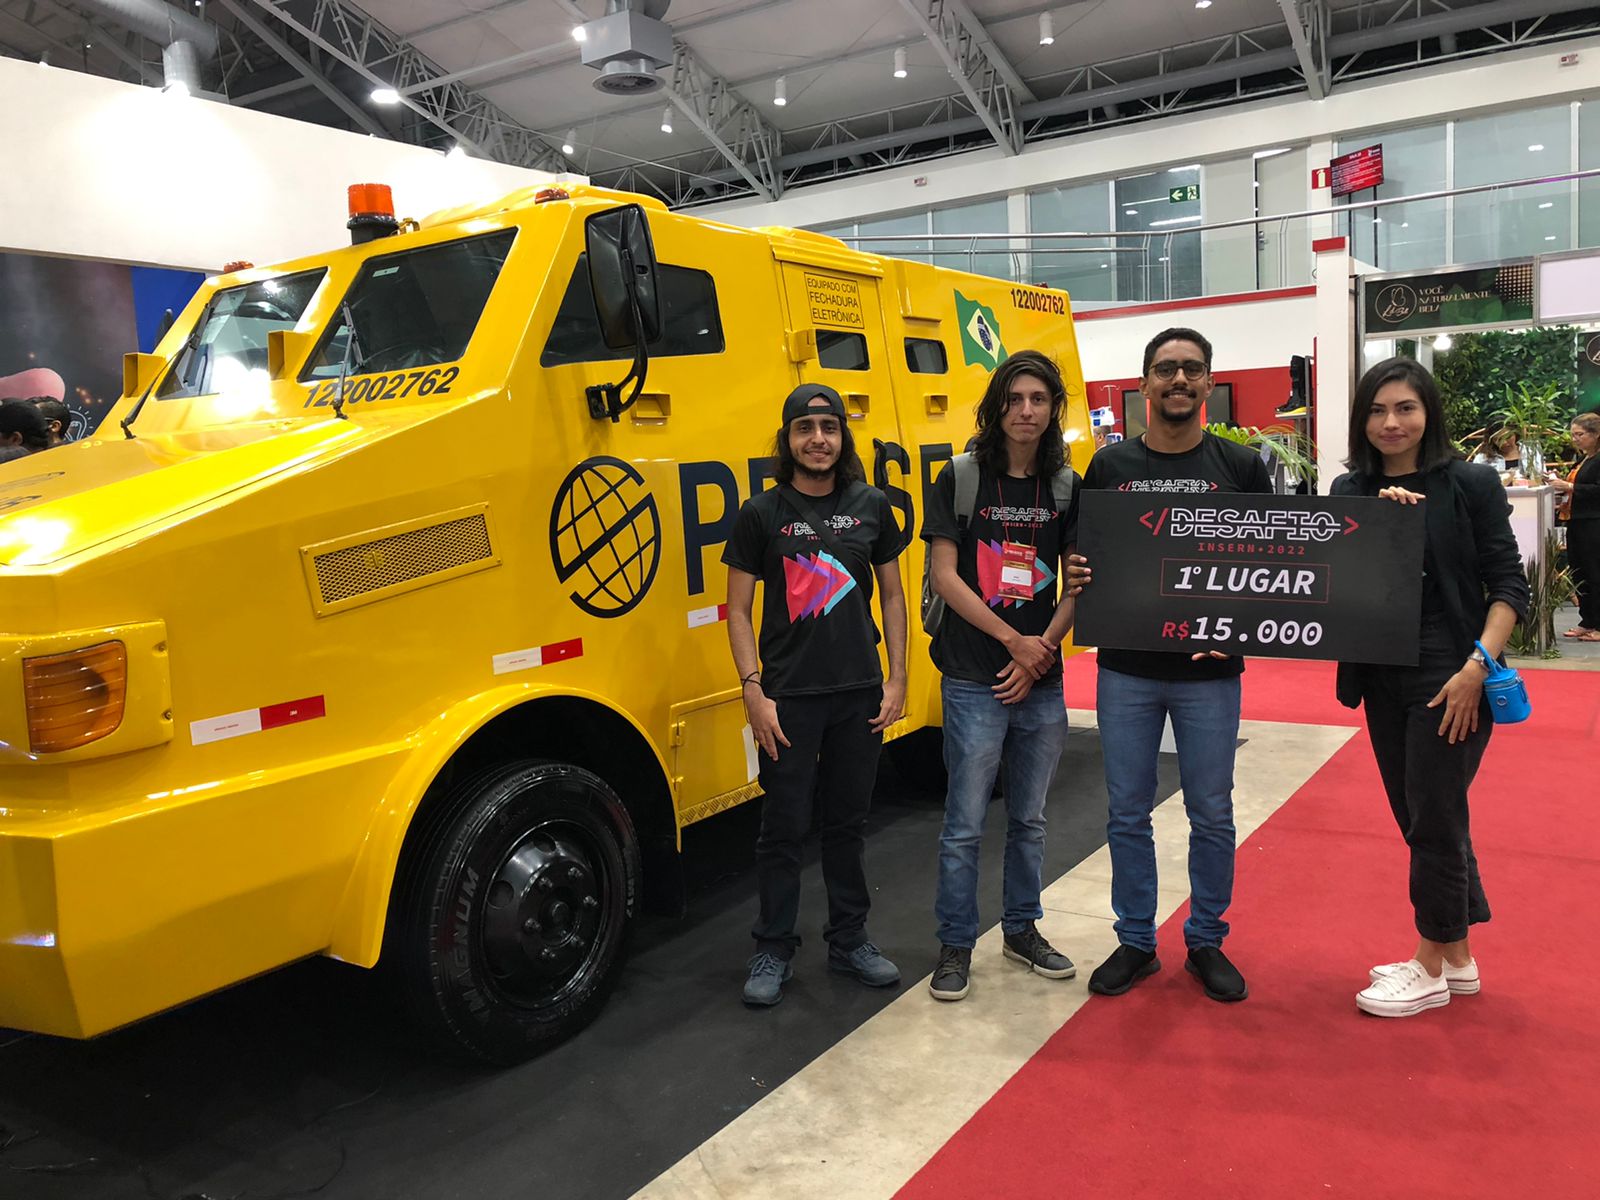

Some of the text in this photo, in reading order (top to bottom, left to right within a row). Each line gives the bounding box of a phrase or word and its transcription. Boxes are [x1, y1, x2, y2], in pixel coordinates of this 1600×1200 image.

[807, 278, 857, 293] EQUIPADO COM
[809, 291, 859, 308] FECHADURA
[1010, 288, 1065, 315] 122002762
[812, 308, 862, 324] ELETRÔNICA
[1206, 567, 1316, 595] LUGAR
[453, 866, 491, 1023] MAGNUM
